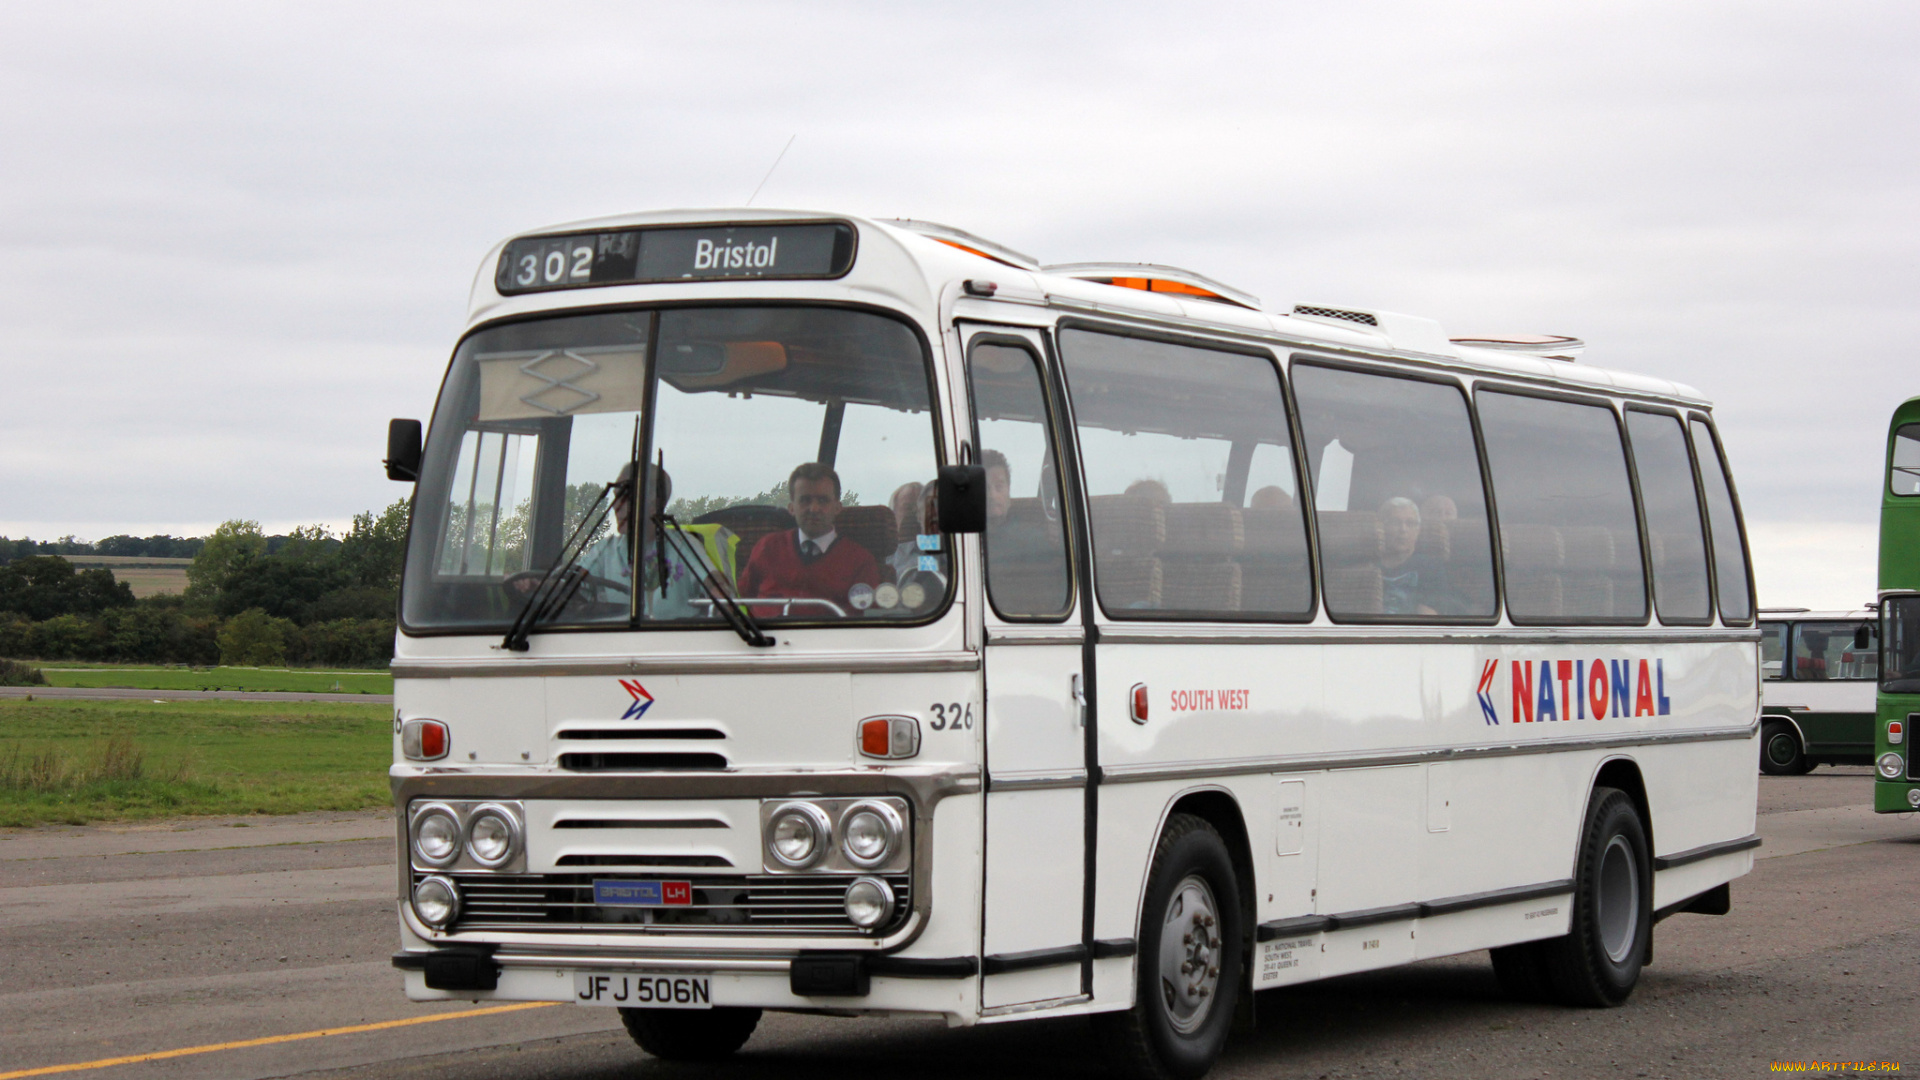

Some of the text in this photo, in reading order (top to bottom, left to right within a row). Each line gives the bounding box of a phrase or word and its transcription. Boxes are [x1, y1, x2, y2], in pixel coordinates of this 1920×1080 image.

[516, 246, 594, 286] 302
[694, 236, 778, 270] Bristol
[1170, 689, 1250, 712] SOUTH WEST
[1511, 658, 1671, 723] NATIONAL
[929, 702, 973, 731] 326
[599, 886, 686, 898] BRISTOL LH
[1264, 953, 1279, 963] SOUTH
[578, 976, 710, 1004] JFJ 506N
